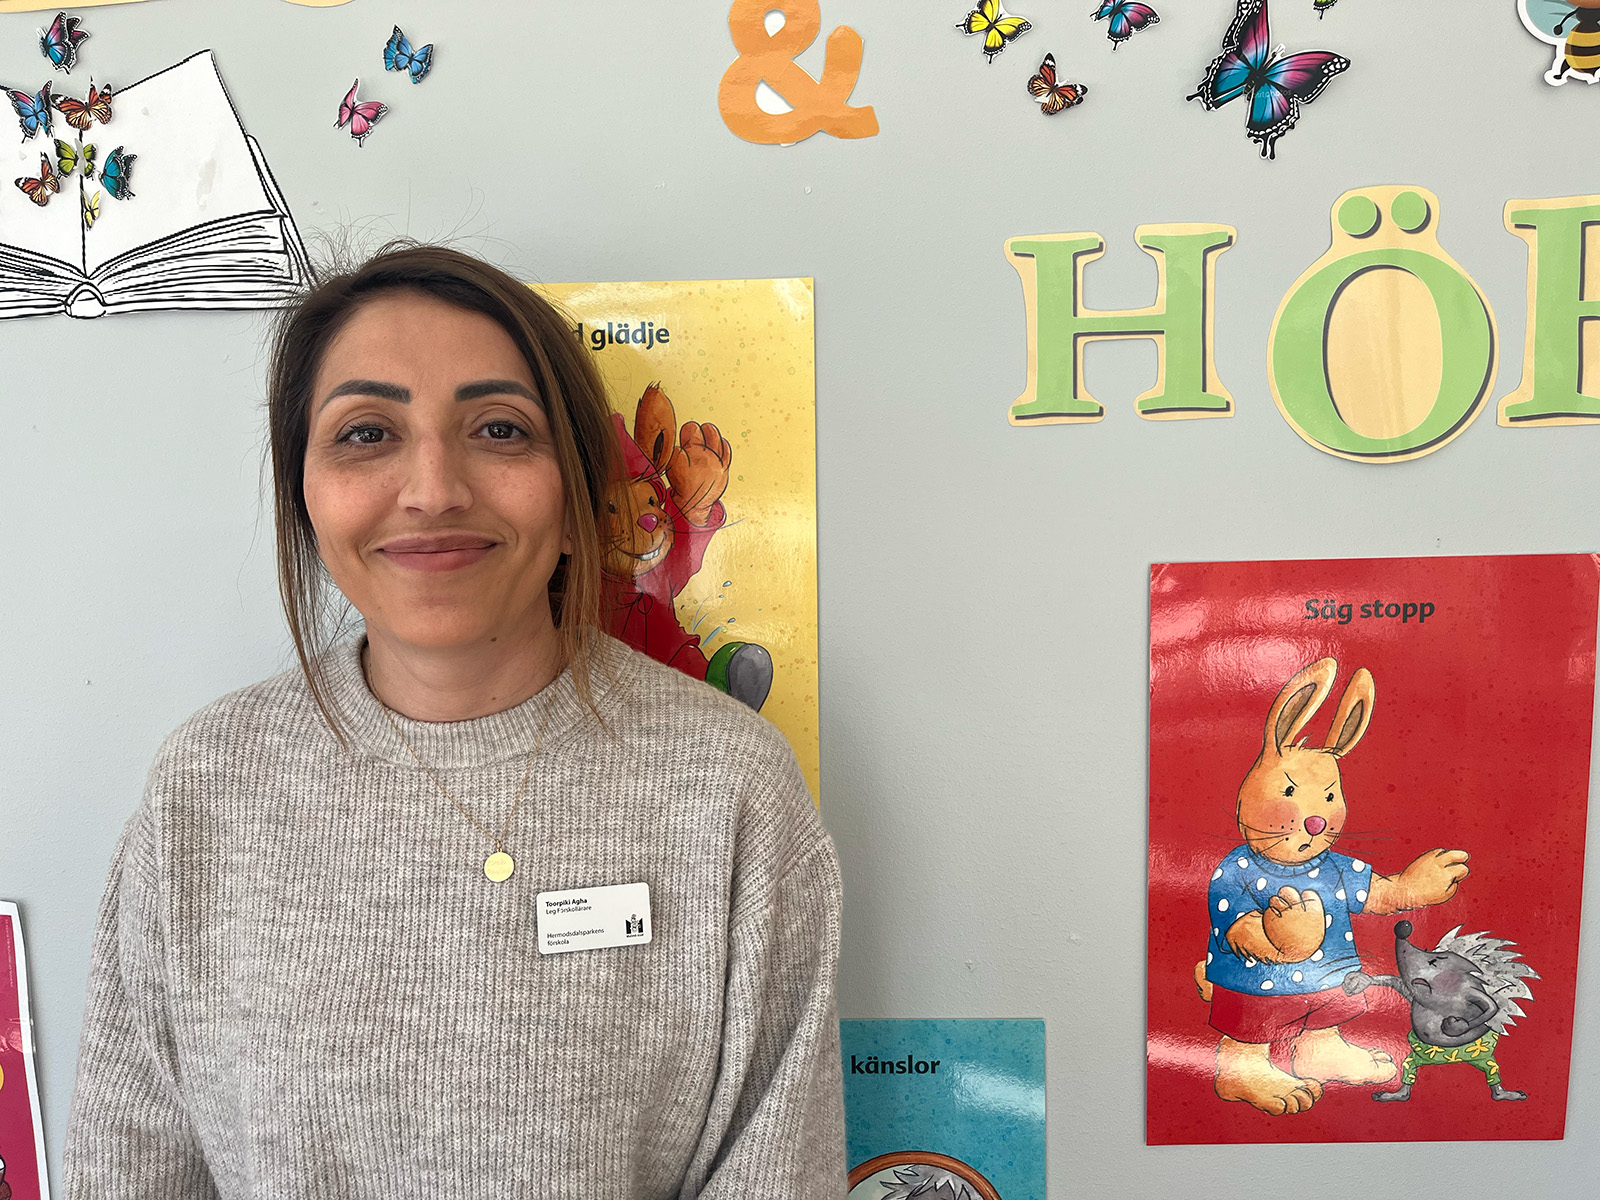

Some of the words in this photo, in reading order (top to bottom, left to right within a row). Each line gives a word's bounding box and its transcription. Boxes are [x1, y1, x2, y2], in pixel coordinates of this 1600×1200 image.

[718, 0, 880, 145] &
[591, 321, 670, 351] glädje
[1304, 599, 1353, 625] Säg
[1360, 600, 1436, 624] stopp
[546, 928, 605, 938] Hermodsdalsparkens
[850, 1054, 941, 1075] känslor
